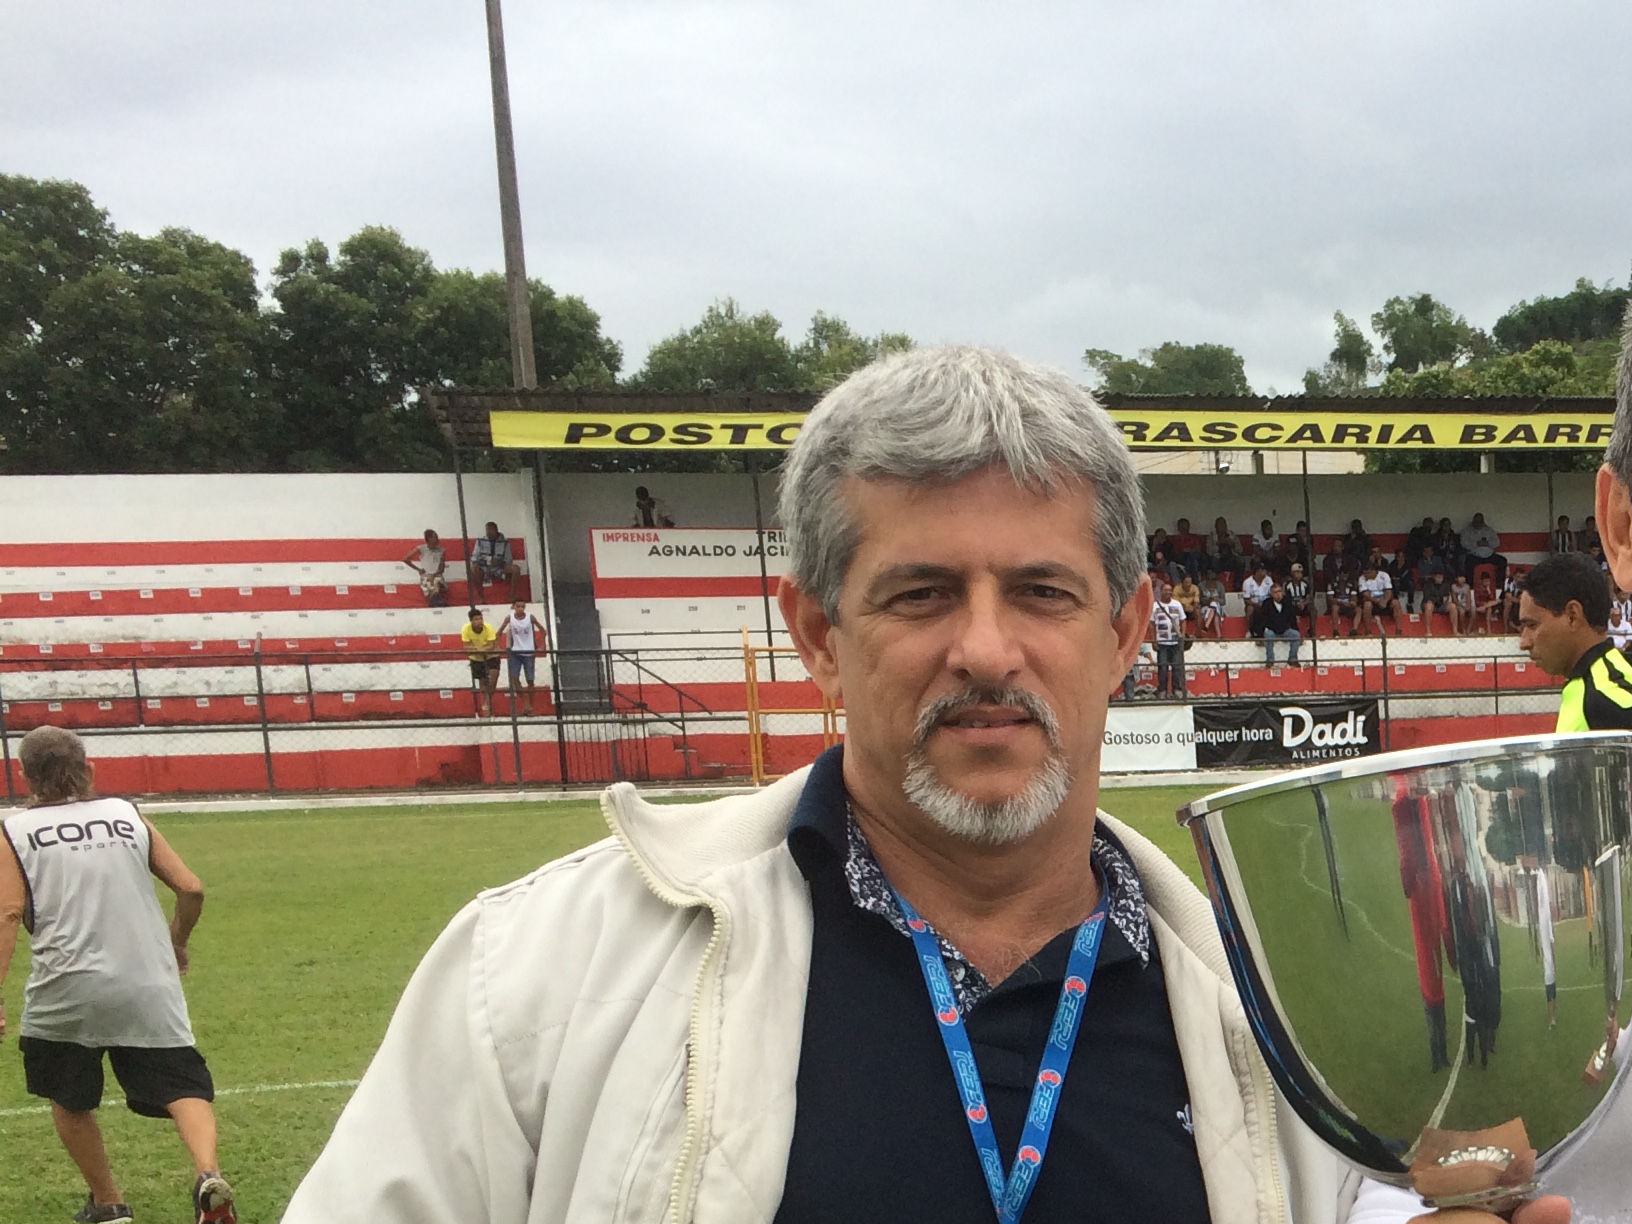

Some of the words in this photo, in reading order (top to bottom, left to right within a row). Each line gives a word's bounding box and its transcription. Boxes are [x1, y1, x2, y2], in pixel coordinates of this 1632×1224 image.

[602, 532, 660, 543] IMPRENSA
[648, 545, 737, 557] AGNALDO
[743, 545, 789, 557] JACI
[1279, 707, 1368, 747] Dadi
[1102, 730, 1161, 745] Gostoso
[1165, 732, 1173, 744] a
[1177, 728, 1239, 749] qualquer
[1242, 727, 1273, 742] hora
[1292, 747, 1361, 760] ALIMENTOS
